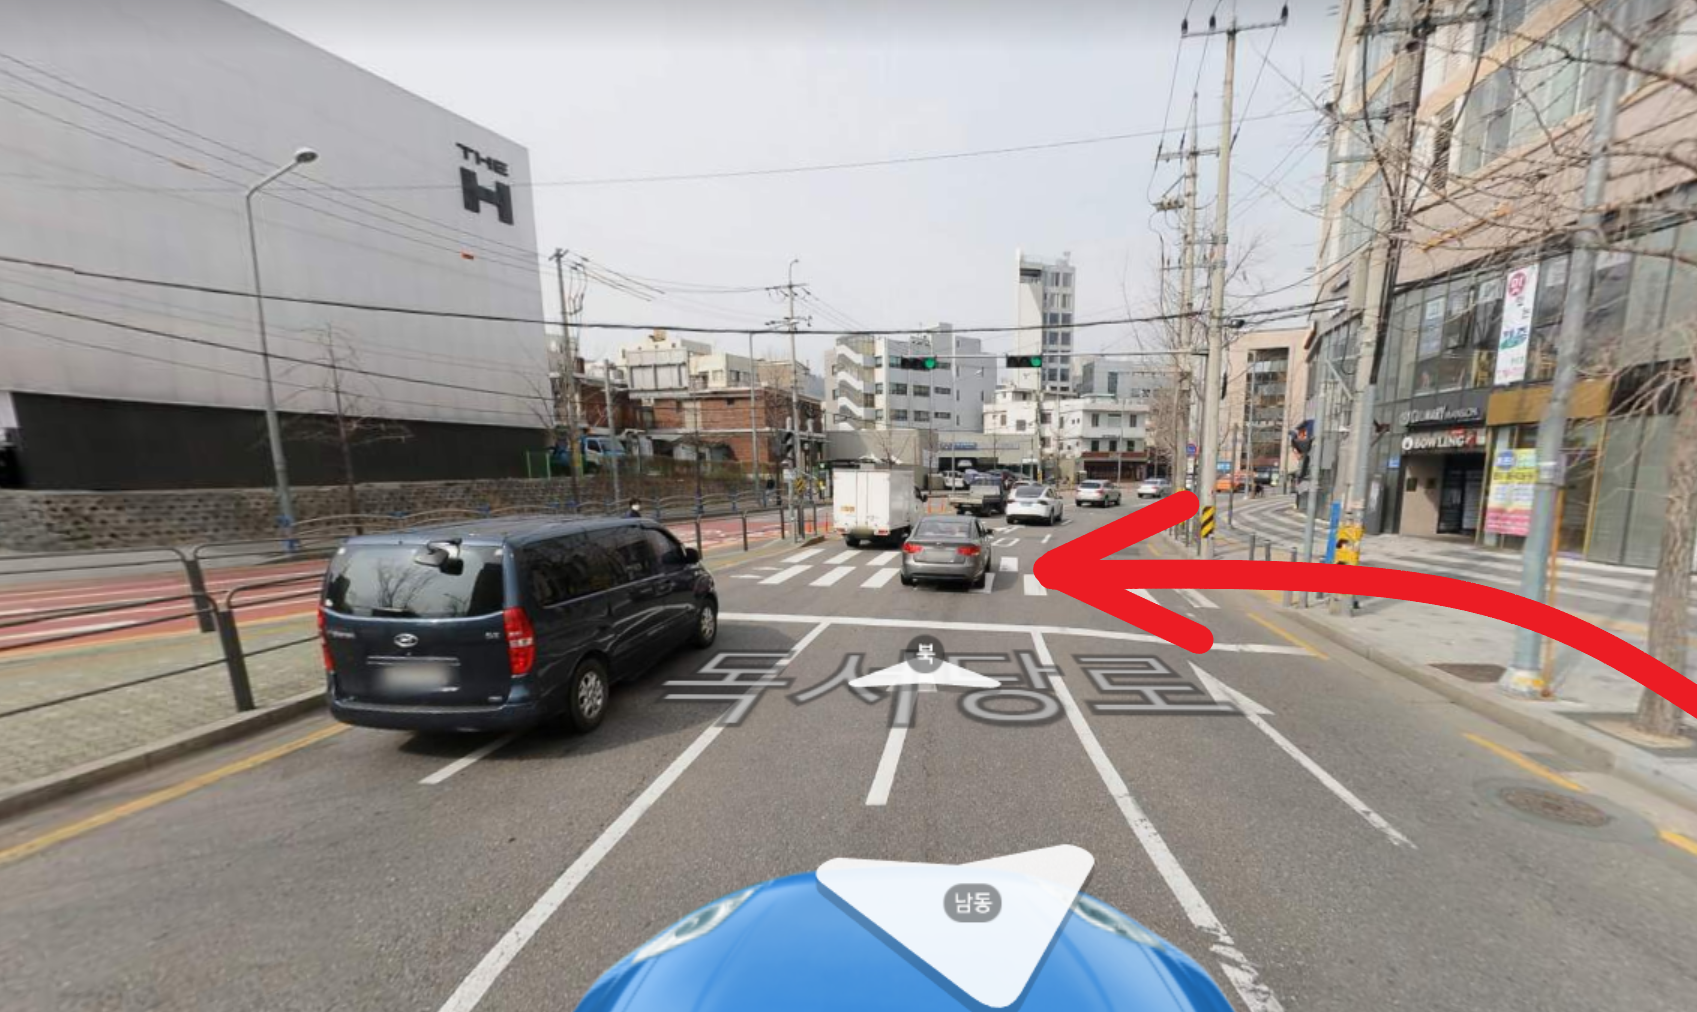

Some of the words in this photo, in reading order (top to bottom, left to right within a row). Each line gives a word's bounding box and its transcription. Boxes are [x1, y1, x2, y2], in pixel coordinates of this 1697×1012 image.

[455, 142, 509, 177] THE
[460, 166, 514, 226] H
[1413, 433, 1465, 449] BOWLING
